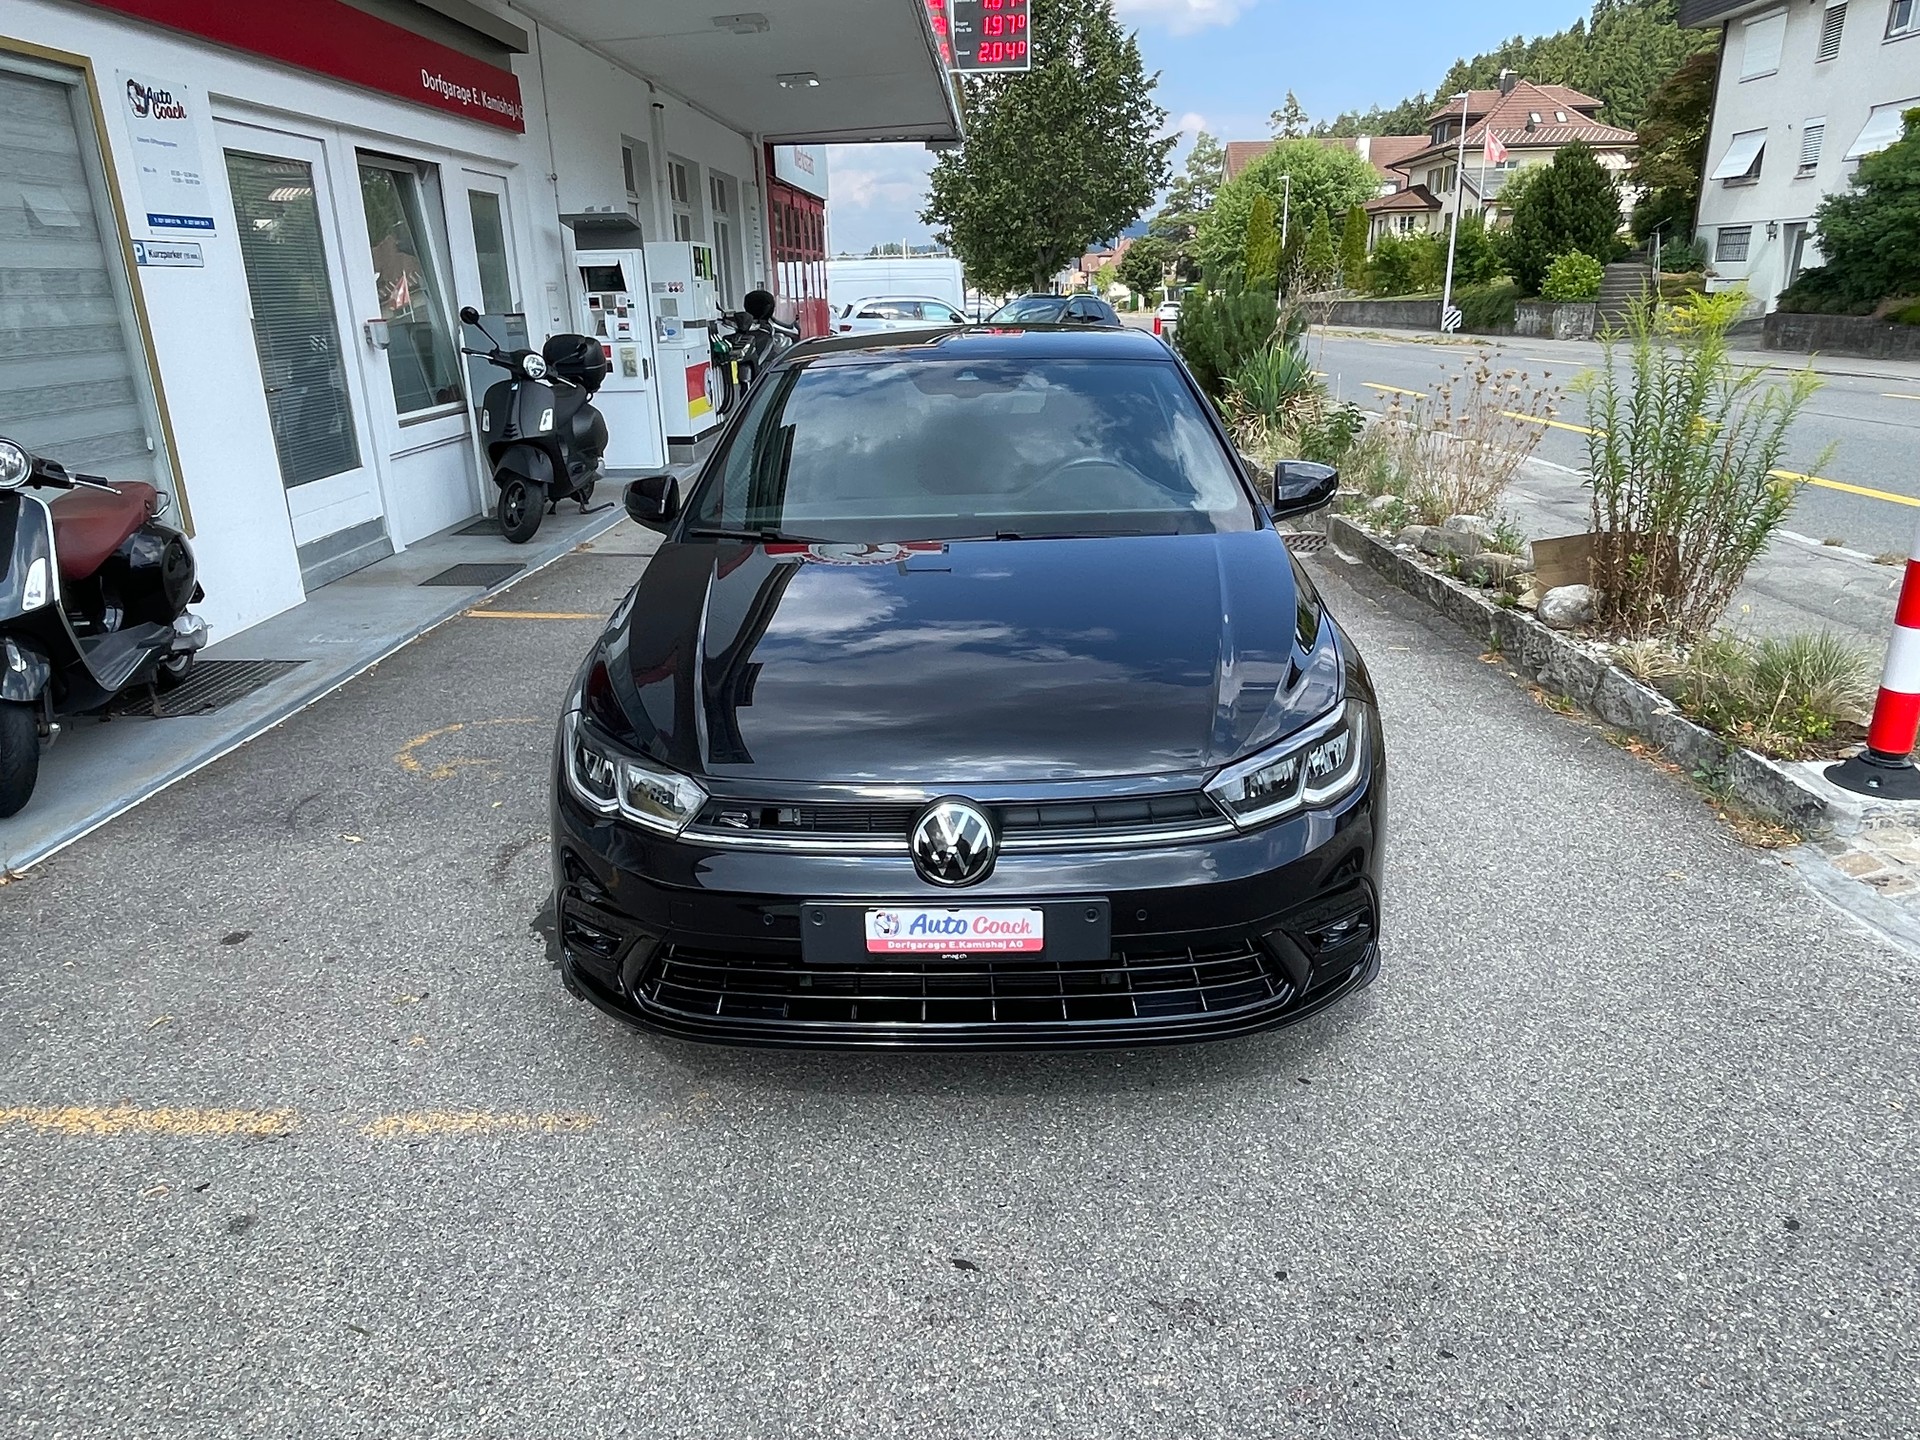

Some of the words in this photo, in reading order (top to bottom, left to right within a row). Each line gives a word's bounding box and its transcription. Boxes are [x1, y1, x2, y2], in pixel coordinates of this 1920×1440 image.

[146, 86, 172, 106] Auto
[421, 68, 472, 106] Dorfgarage
[472, 87, 481, 106] E.
[481, 90, 516, 122] Kamishaj
[152, 101, 187, 119] Coach
[133, 243, 144, 263] P
[147, 249, 183, 261] Kurzparker
[909, 913, 968, 936] Auto
[972, 916, 1033, 935] Coach
[887, 940, 947, 950] Dorfgarage
[948, 940, 1007, 950] E.Kamishaj
[1009, 940, 1024, 949] AG
